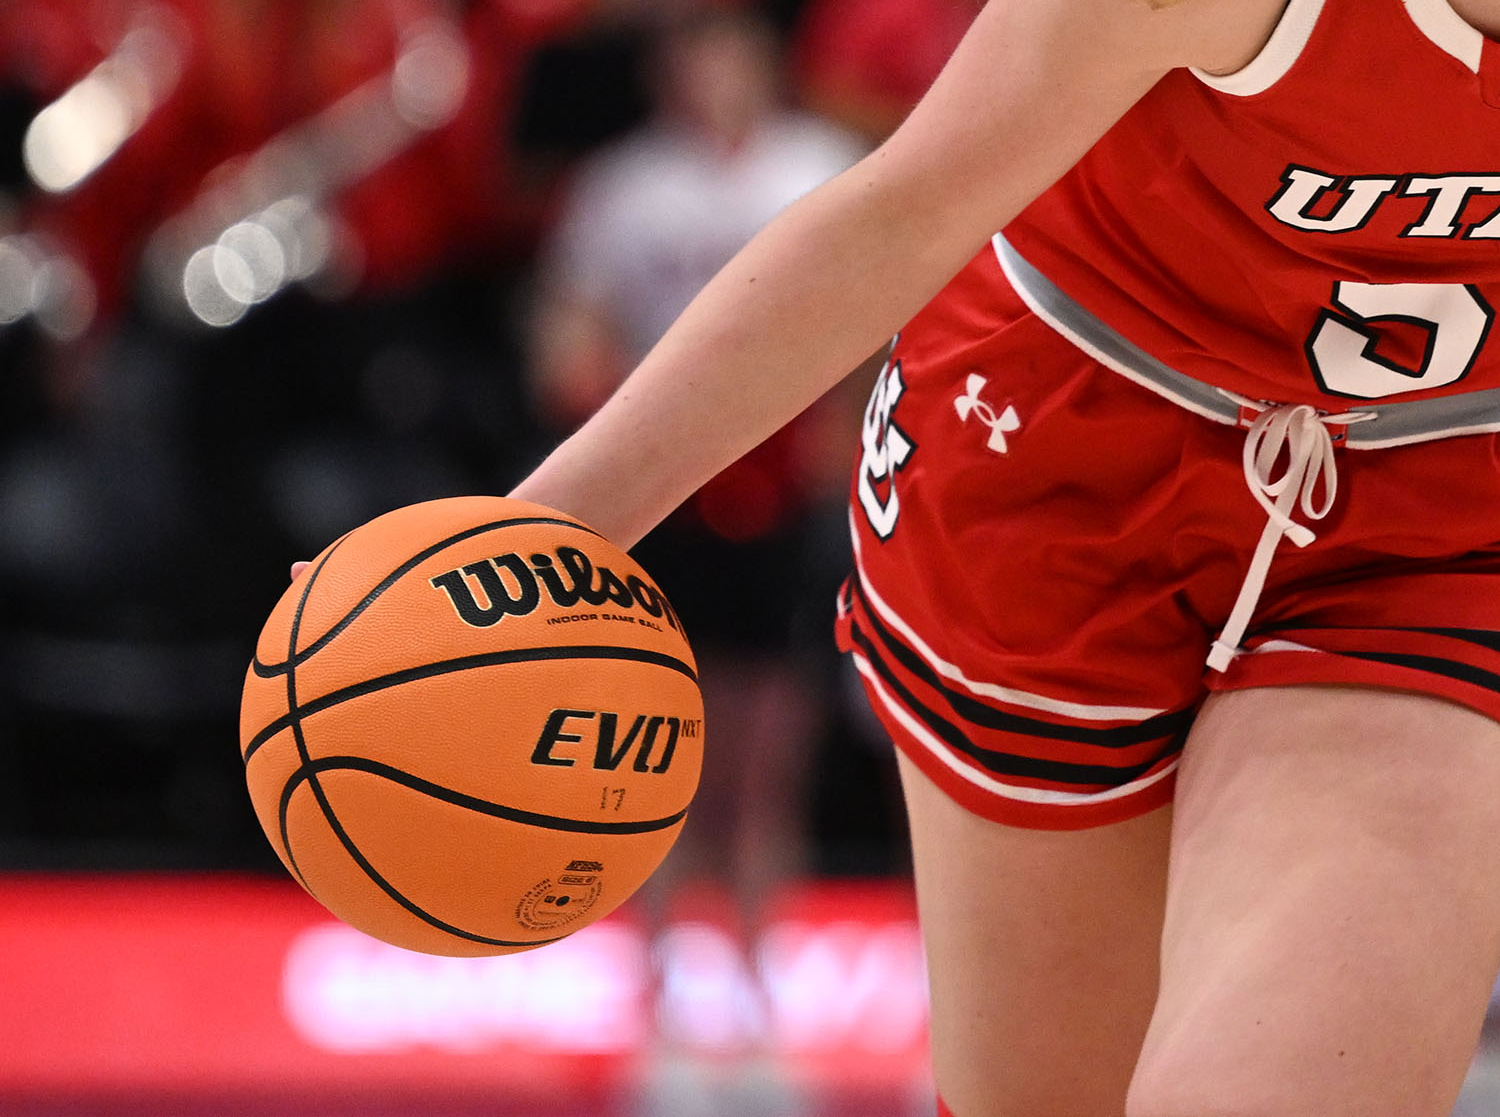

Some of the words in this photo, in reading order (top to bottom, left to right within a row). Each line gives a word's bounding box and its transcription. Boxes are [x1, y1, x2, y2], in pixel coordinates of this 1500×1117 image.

[428, 546, 688, 643] Wilson
[546, 613, 598, 626] INDOOR
[602, 613, 635, 624] GAME
[638, 618, 663, 632] BALL
[530, 708, 681, 774] EVO
[681, 719, 702, 738] NXT
